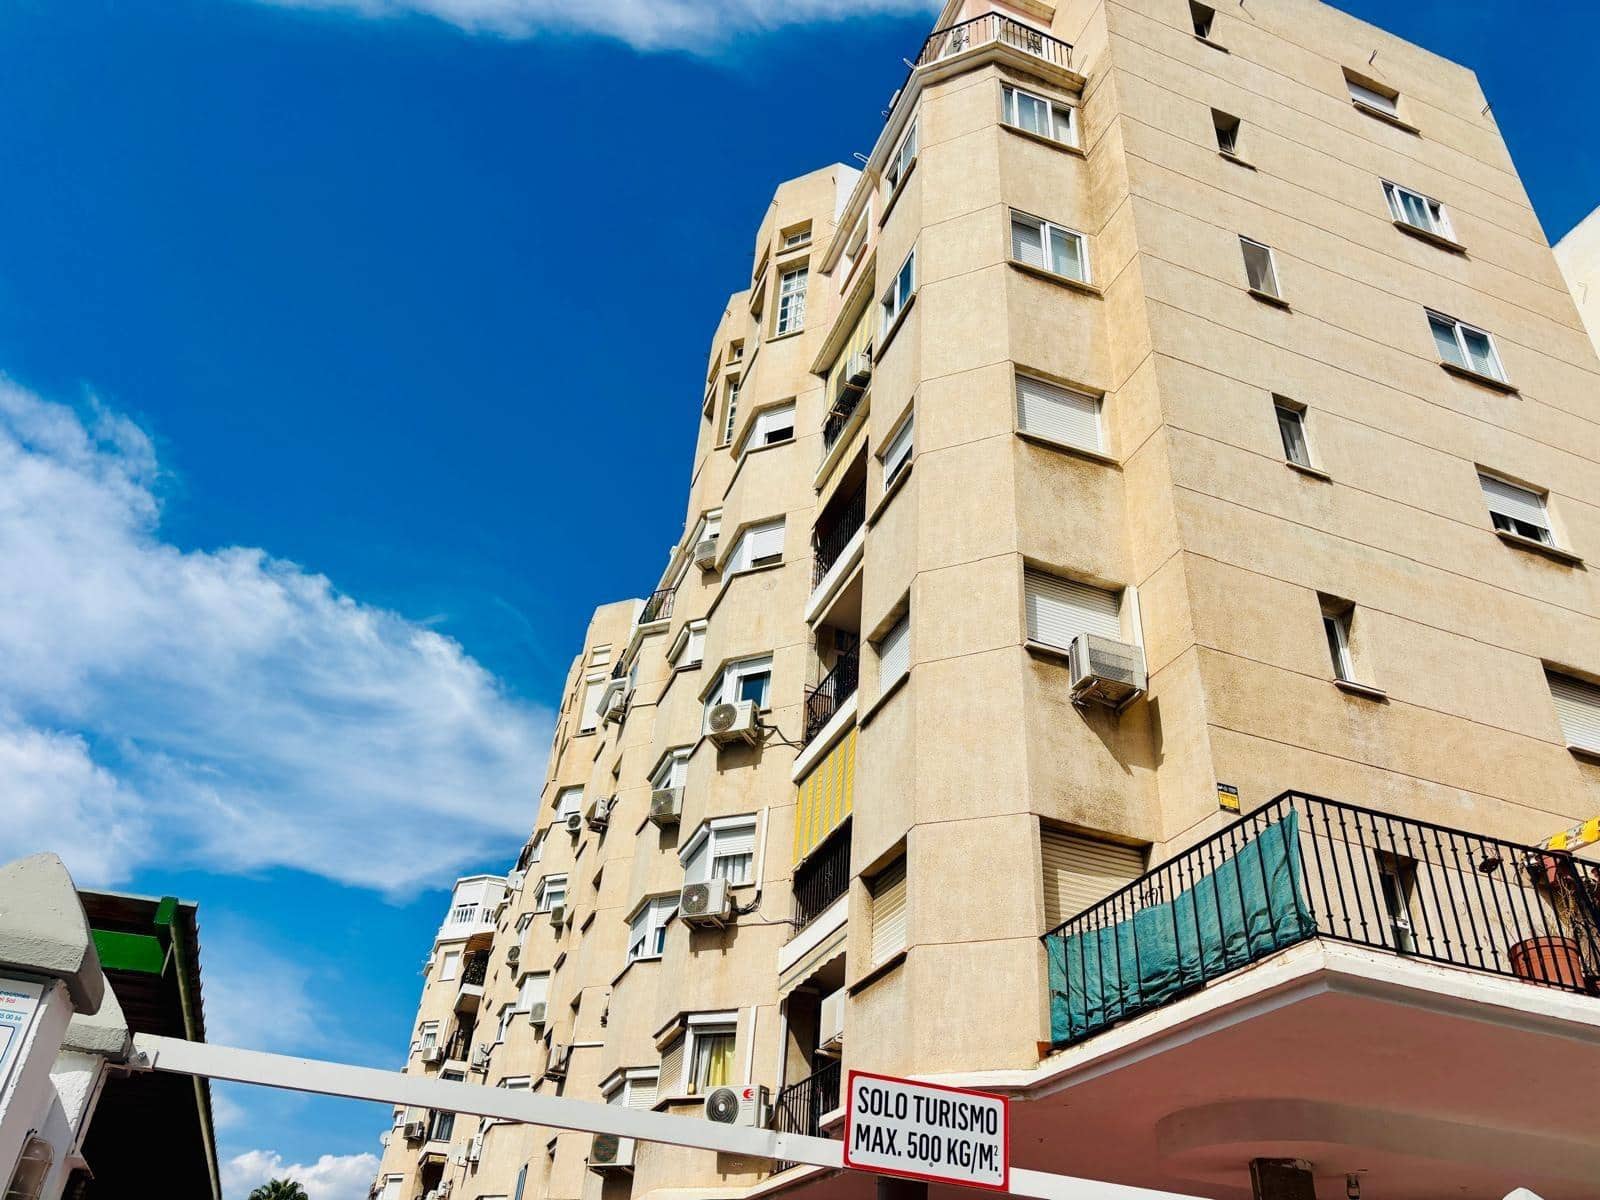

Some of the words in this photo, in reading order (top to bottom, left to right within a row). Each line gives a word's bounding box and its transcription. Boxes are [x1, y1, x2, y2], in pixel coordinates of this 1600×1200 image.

[858, 1086, 907, 1120] SOLO
[913, 1095, 998, 1136] TURISMO
[855, 1123, 902, 1157] MAX.
[907, 1131, 941, 1163] 500
